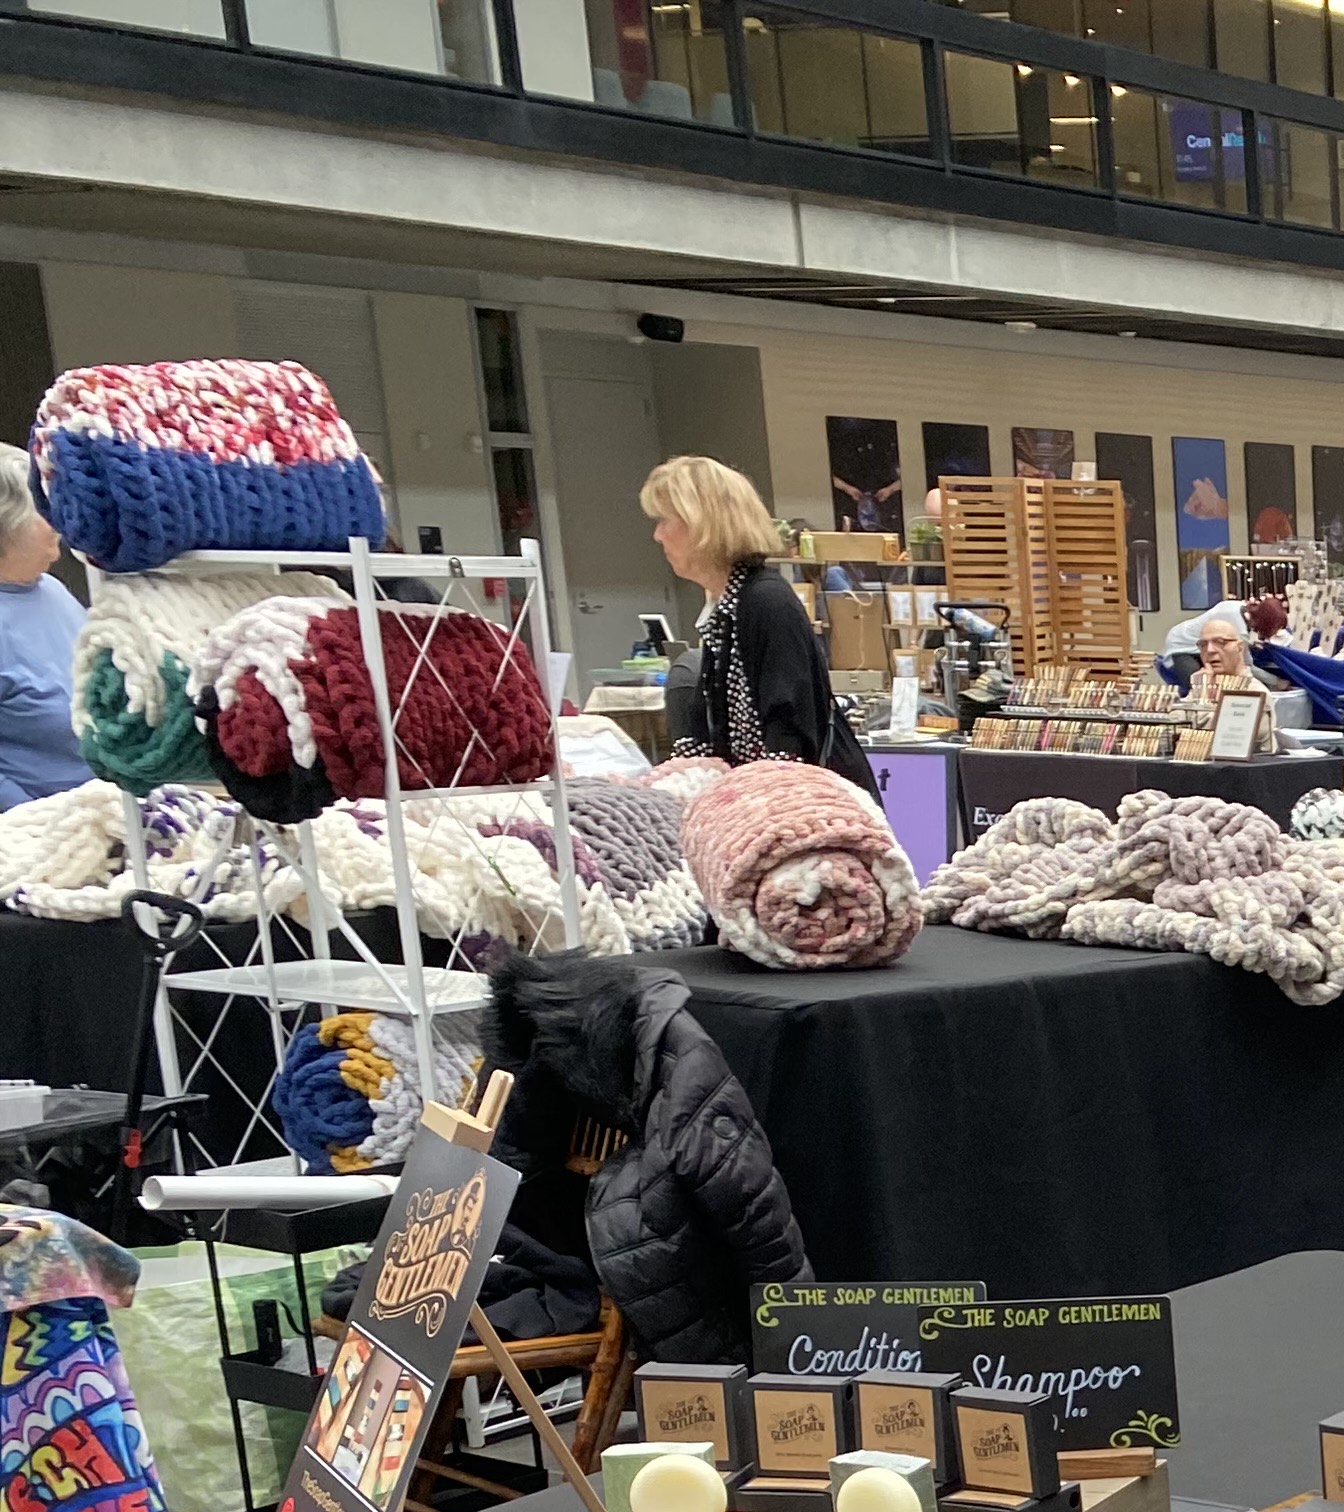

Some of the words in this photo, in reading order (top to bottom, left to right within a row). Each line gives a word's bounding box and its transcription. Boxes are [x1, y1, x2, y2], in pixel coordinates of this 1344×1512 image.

[400, 1213, 452, 1264] SOAP
[376, 1250, 469, 1306] GENTLEMEN
[794, 1288, 826, 1305] THE
[833, 1288, 876, 1305] SOAP
[882, 1287, 975, 1305] GENTLEMEN
[962, 1308, 996, 1328] THE
[1003, 1308, 1050, 1328] SOAP
[1058, 1303, 1161, 1325] GENTLEMEN
[961, 1354, 1141, 1418] Shampoo
